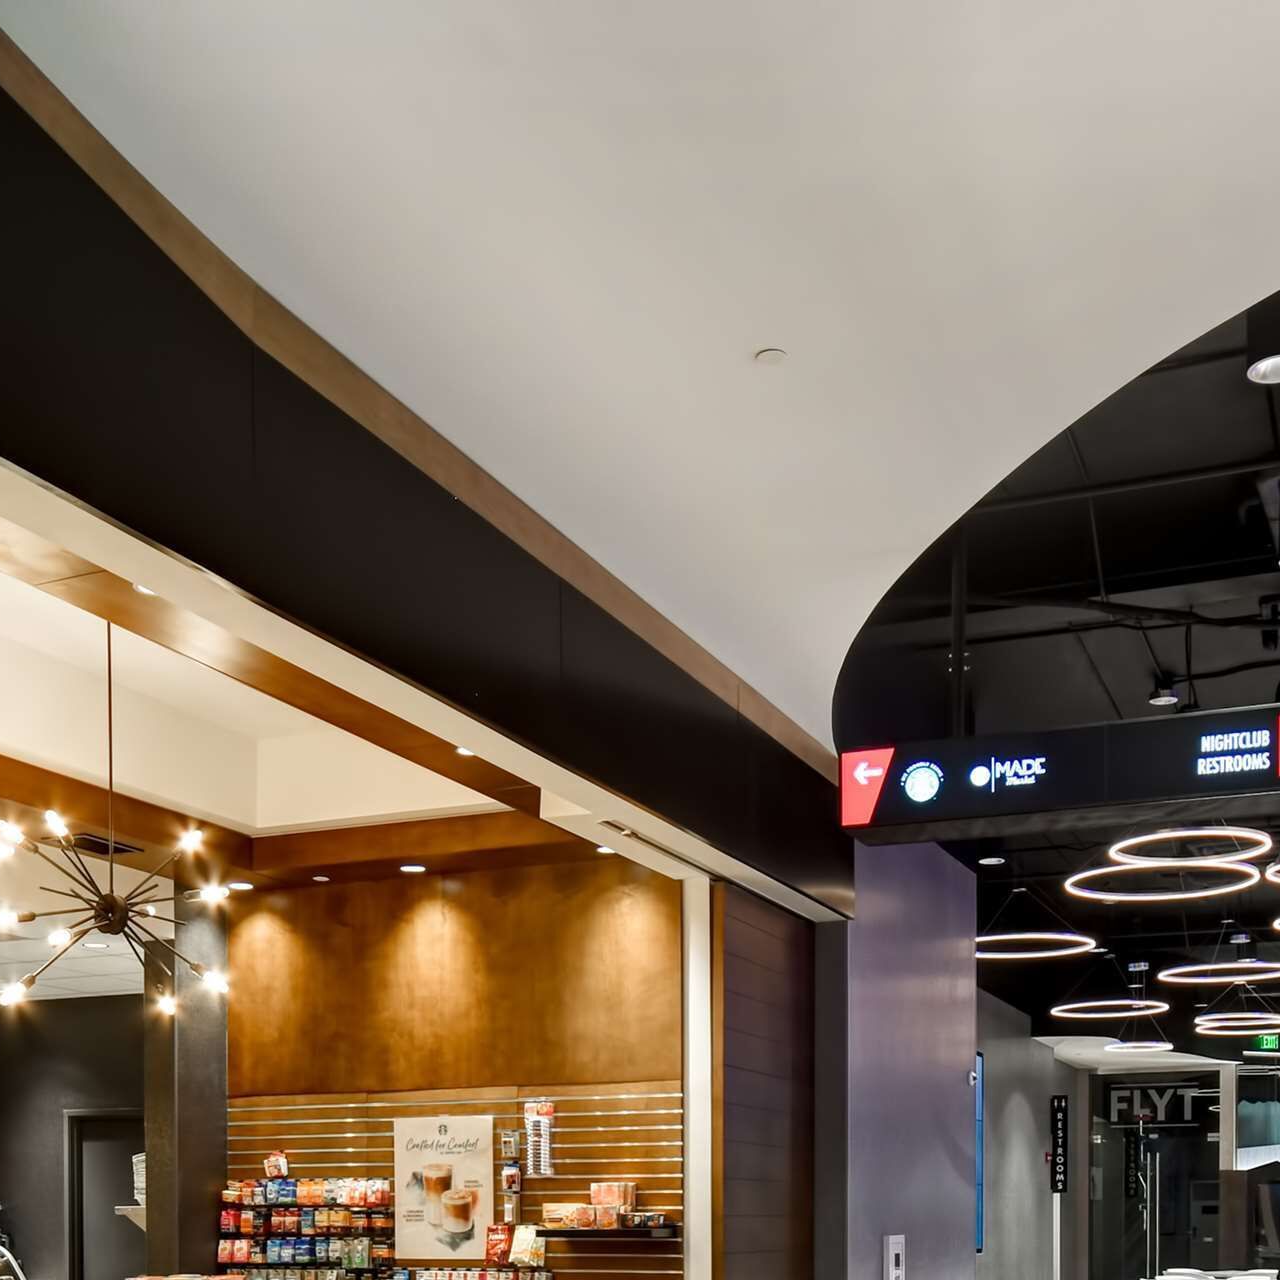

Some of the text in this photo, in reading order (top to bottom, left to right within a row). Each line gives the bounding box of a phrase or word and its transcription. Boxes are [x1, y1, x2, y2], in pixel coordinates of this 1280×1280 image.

[1200, 730, 1271, 753] NIGHTCLUB
[995, 757, 1046, 778] MADE
[1197, 752, 1271, 775] RESTROOMS
[1109, 1088, 1200, 1122] FLYT
[406, 1137, 480, 1152] Crafted for Comfort
[1056, 1112, 1065, 1190] RESTROOMS
